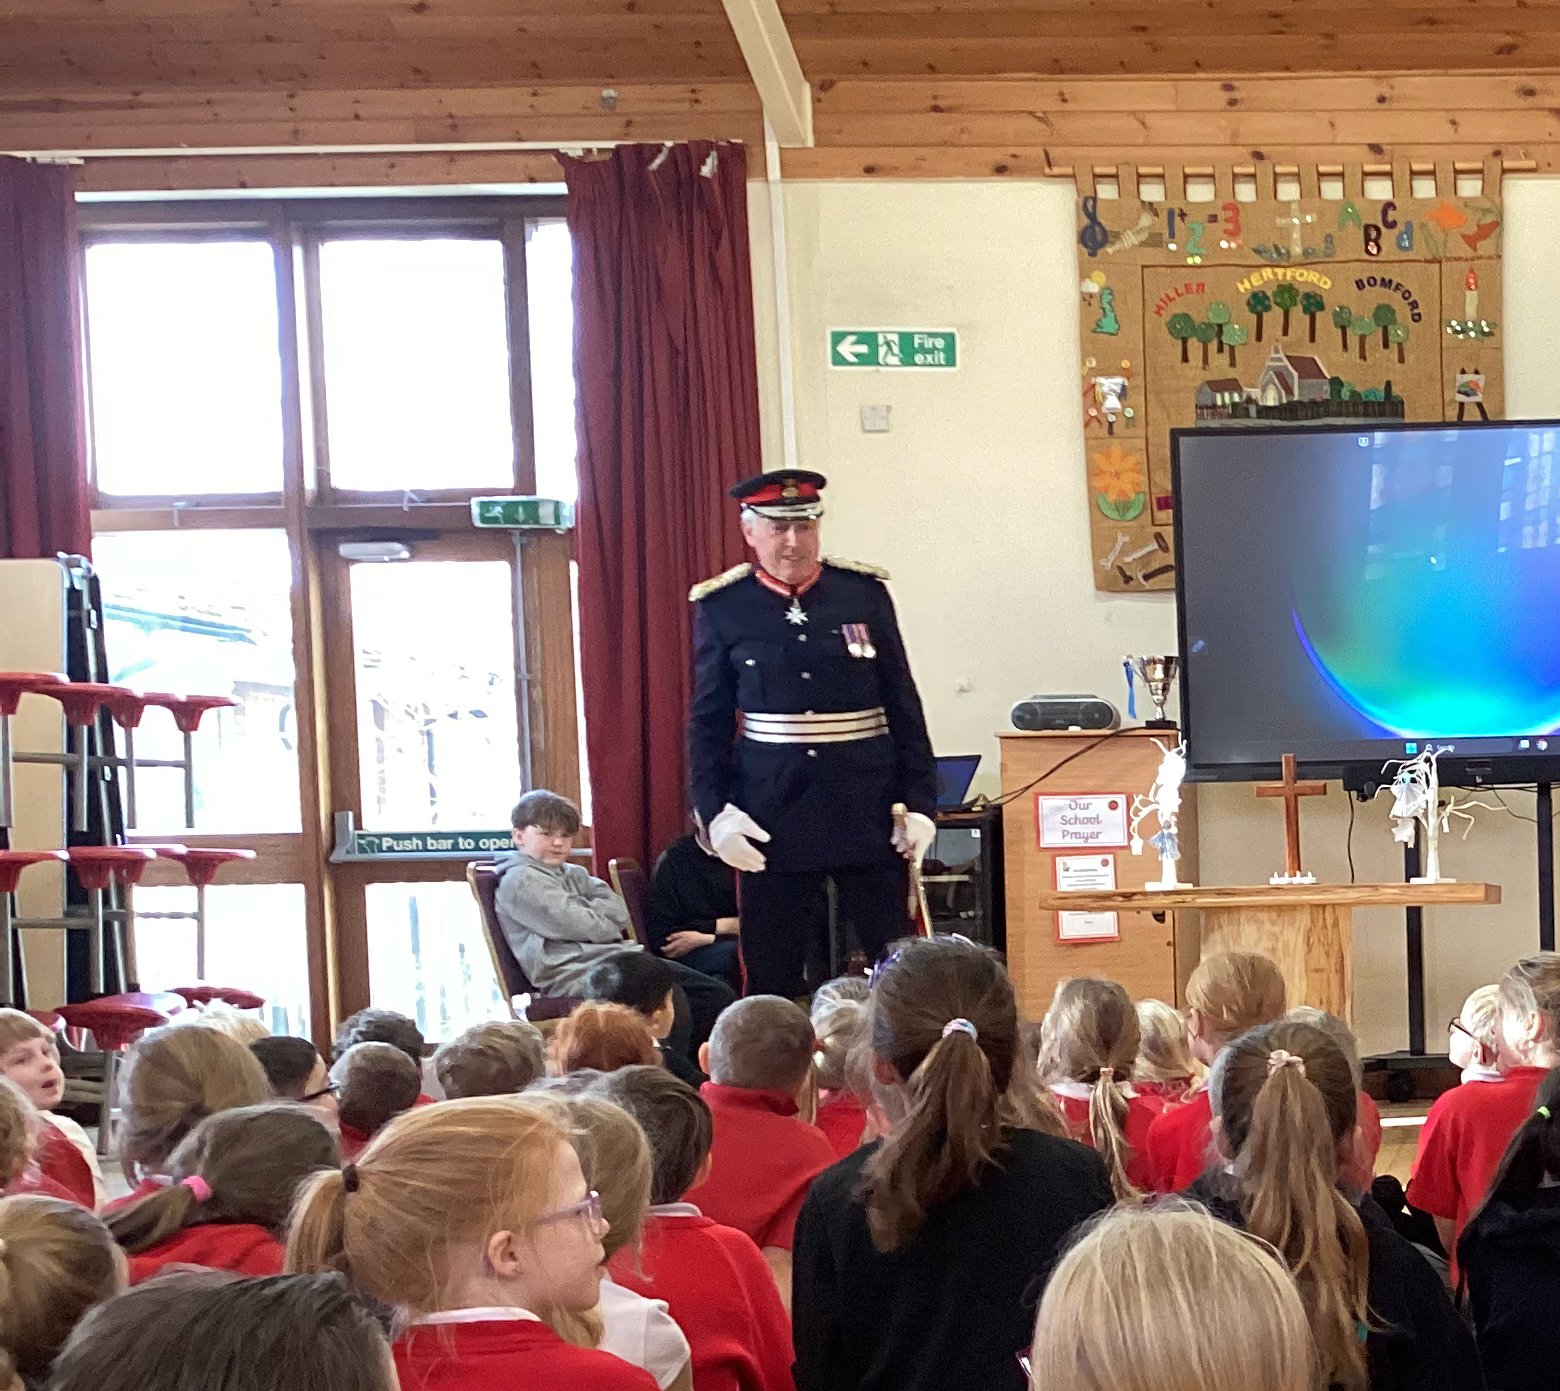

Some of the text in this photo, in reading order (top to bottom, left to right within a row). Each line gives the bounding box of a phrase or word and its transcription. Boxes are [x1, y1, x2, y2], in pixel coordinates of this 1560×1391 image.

[1236, 267, 1332, 293] HERTFORD
[1152, 282, 1206, 317] MILLER
[1354, 276, 1422, 324] BOMFORD
[913, 333, 945, 349] Fire
[913, 350, 947, 365] exit
[1068, 800, 1093, 811] Our
[1060, 813, 1103, 826] School
[381, 837, 422, 851] Push
[426, 836, 454, 850] bar
[458, 836, 475, 850] to
[1061, 829, 1103, 844] Prayer
